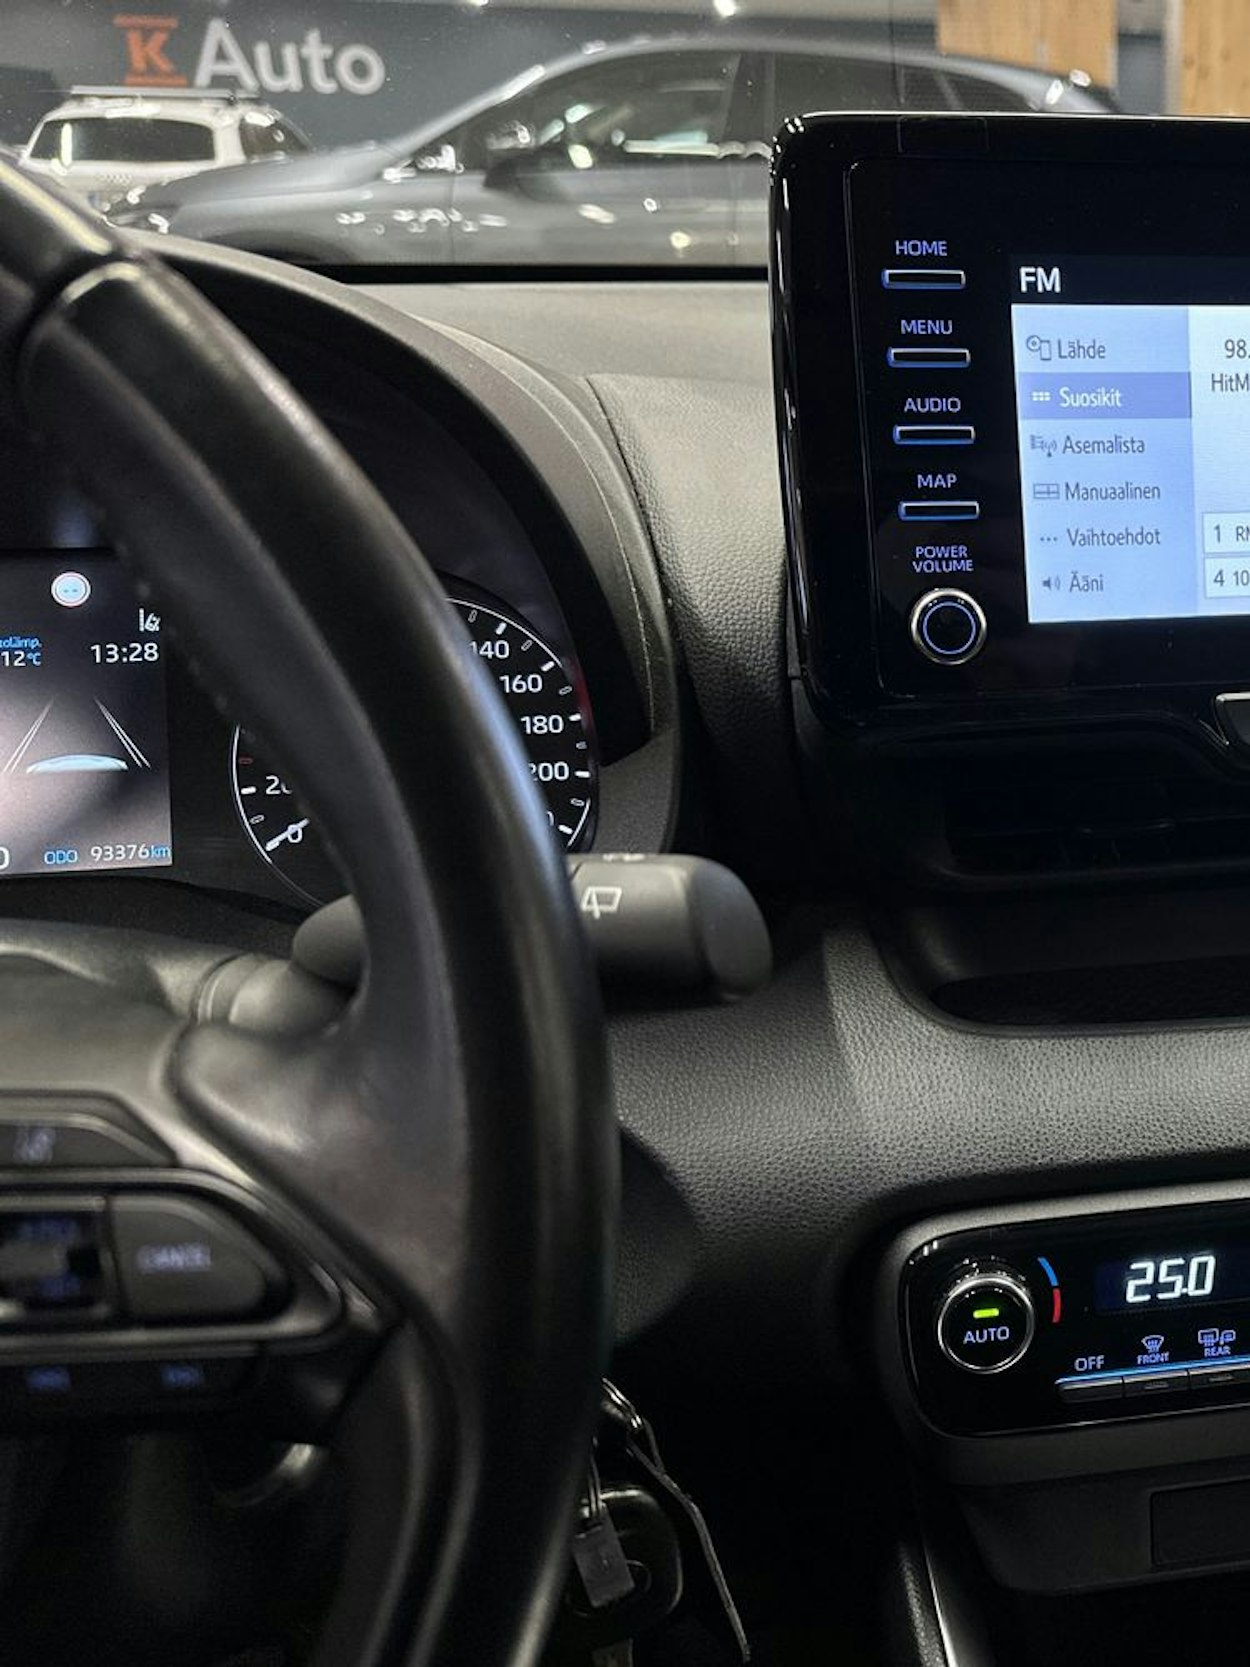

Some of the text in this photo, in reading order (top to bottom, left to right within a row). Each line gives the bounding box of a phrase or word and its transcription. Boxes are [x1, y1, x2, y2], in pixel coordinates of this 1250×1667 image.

[194, 19, 386, 96] Auto
[895, 240, 948, 256] HOME
[1019, 266, 1062, 293] FM
[900, 319, 953, 335] MENU
[1057, 338, 1106, 360] Lähde
[904, 397, 962, 413] AUDIO
[1058, 386, 1122, 409] Suosikit
[1062, 434, 1146, 455] Asemalista
[917, 474, 958, 489] MAP
[1064, 480, 1161, 501] Manuaalinen
[1066, 527, 1161, 545] Vaihtoehdot
[1213, 525, 1222, 543] 1
[915, 546, 968, 559] POWER
[912, 560, 974, 573] VOLUME
[1069, 572, 1104, 593] Ääni
[1213, 568, 1225, 587] 4
[90, 642, 160, 663] 13:28
[499, 673, 543, 694] 160
[520, 714, 564, 735] 180
[44, 849, 78, 865] ODO
[1125, 1254, 1217, 1303] 25.0
[963, 1325, 1010, 1345] AUTO
[1137, 1351, 1170, 1365] FRONT
[1204, 1345, 1231, 1358] REAR
[1074, 1355, 1105, 1372] OFF
